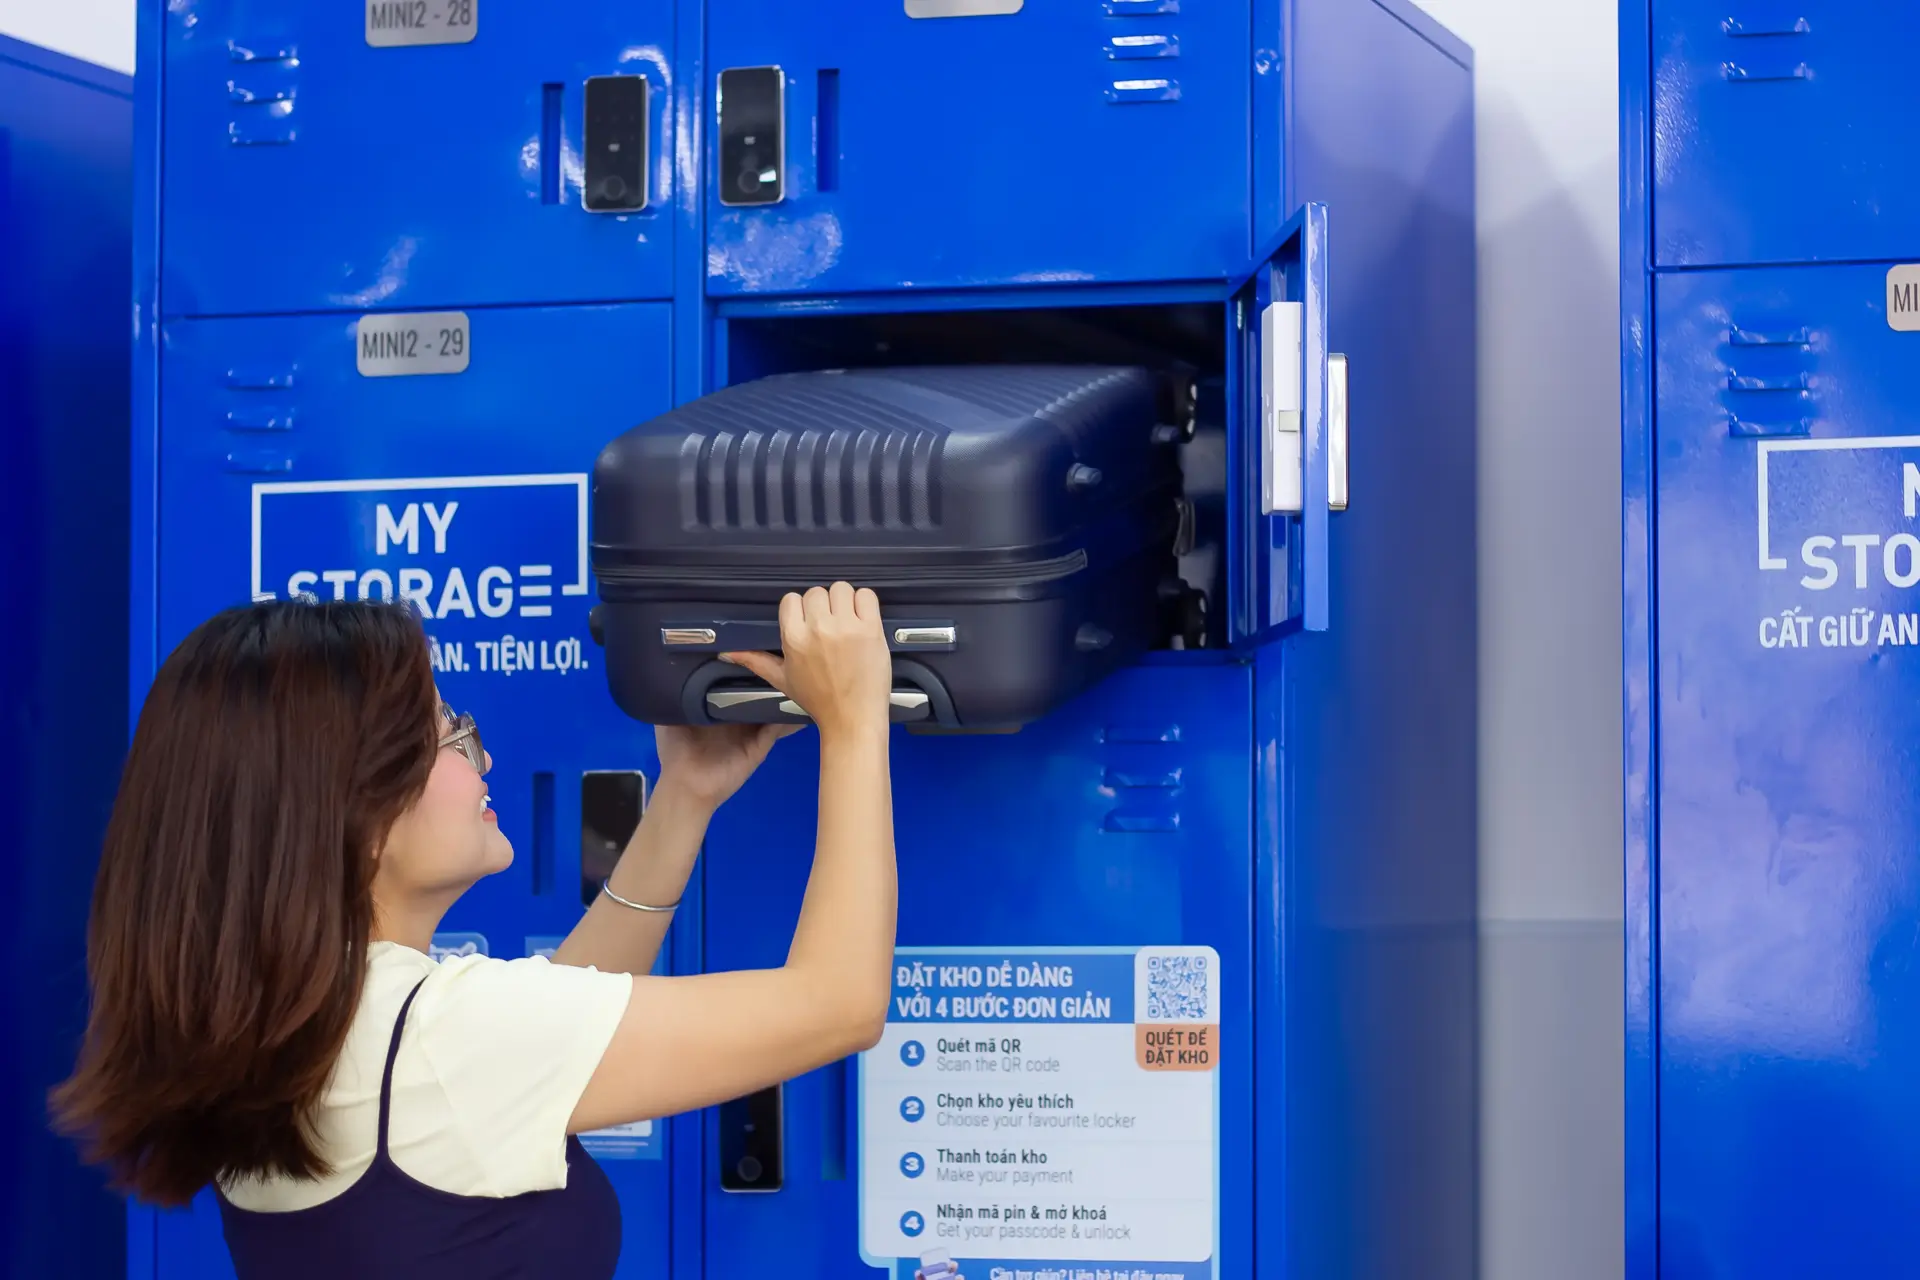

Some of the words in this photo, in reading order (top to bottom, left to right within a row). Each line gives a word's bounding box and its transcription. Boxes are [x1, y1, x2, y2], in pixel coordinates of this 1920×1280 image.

[371, 1, 426, 30] MINI2
[446, 0, 473, 27] 28
[362, 329, 418, 360] MINI2
[439, 328, 464, 357] 29
[376, 501, 459, 556] MY
[1759, 606, 1814, 649] CẤT
[1819, 607, 1875, 647] GIỮ
[1877, 612, 1919, 646] AN
[475, 634, 535, 677] TIỆN
[540, 636, 589, 675] LỢI.
[896, 962, 936, 992] ĐẶT
[940, 966, 982, 988] KHO
[987, 960, 1012, 987] DỄ
[1016, 962, 1073, 987] DÀNG
[896, 993, 931, 1018] VỚI
[935, 997, 948, 1018] 4
[952, 992, 1009, 1018] BƯỚC
[1012, 997, 1057, 1018] ĐƠN
[1061, 991, 1112, 1018] GIẢN
[936, 1038, 970, 1054] Quét
[975, 1039, 996, 1053] mã
[1001, 1038, 1021, 1054] QR
[1145, 1028, 1184, 1047] QUÉT
[1188, 1027, 1208, 1046] ĐỂ
[907, 1045, 919, 1059] 1
[1145, 1046, 1175, 1067] ĐẶT
[1178, 1049, 1209, 1064] KHO
[936, 1057, 971, 1072] Scan
[976, 1057, 997, 1072] the
[1001, 1057, 1021, 1073] QR
[1026, 1057, 1060, 1073] code
[905, 1100, 920, 1115] 2
[936, 1093, 973, 1112] Chọn
[977, 1093, 1004, 1109] kho
[1008, 1094, 1033, 1112] yêu
[1038, 1093, 1074, 1109] thích
[936, 1111, 989, 1128] Choose
[993, 1113, 1022, 1131] your
[1028, 1112, 1090, 1128] favourite
[1093, 1112, 1137, 1128] locker
[905, 1156, 920, 1171] 3
[936, 1148, 981, 1164] Thanh
[985, 1148, 1017, 1164] toán
[1021, 1148, 1048, 1164] kho
[936, 1166, 974, 1182] Make
[978, 1168, 1008, 1186] your
[1012, 1167, 1074, 1186] payment
[936, 1203, 973, 1221] Nhận
[978, 1204, 999, 1219] mã
[1003, 1204, 1026, 1222] pin
[1030, 1205, 1040, 1219] &
[1045, 1205, 1068, 1219] mở
[1072, 1205, 1107, 1220] khoá
[904, 1216, 921, 1230] 4
[936, 1222, 960, 1238] Get
[965, 1223, 994, 1240] your
[999, 1223, 1066, 1240] passcode
[1071, 1223, 1080, 1238] &
[1085, 1223, 1131, 1240] unlock
